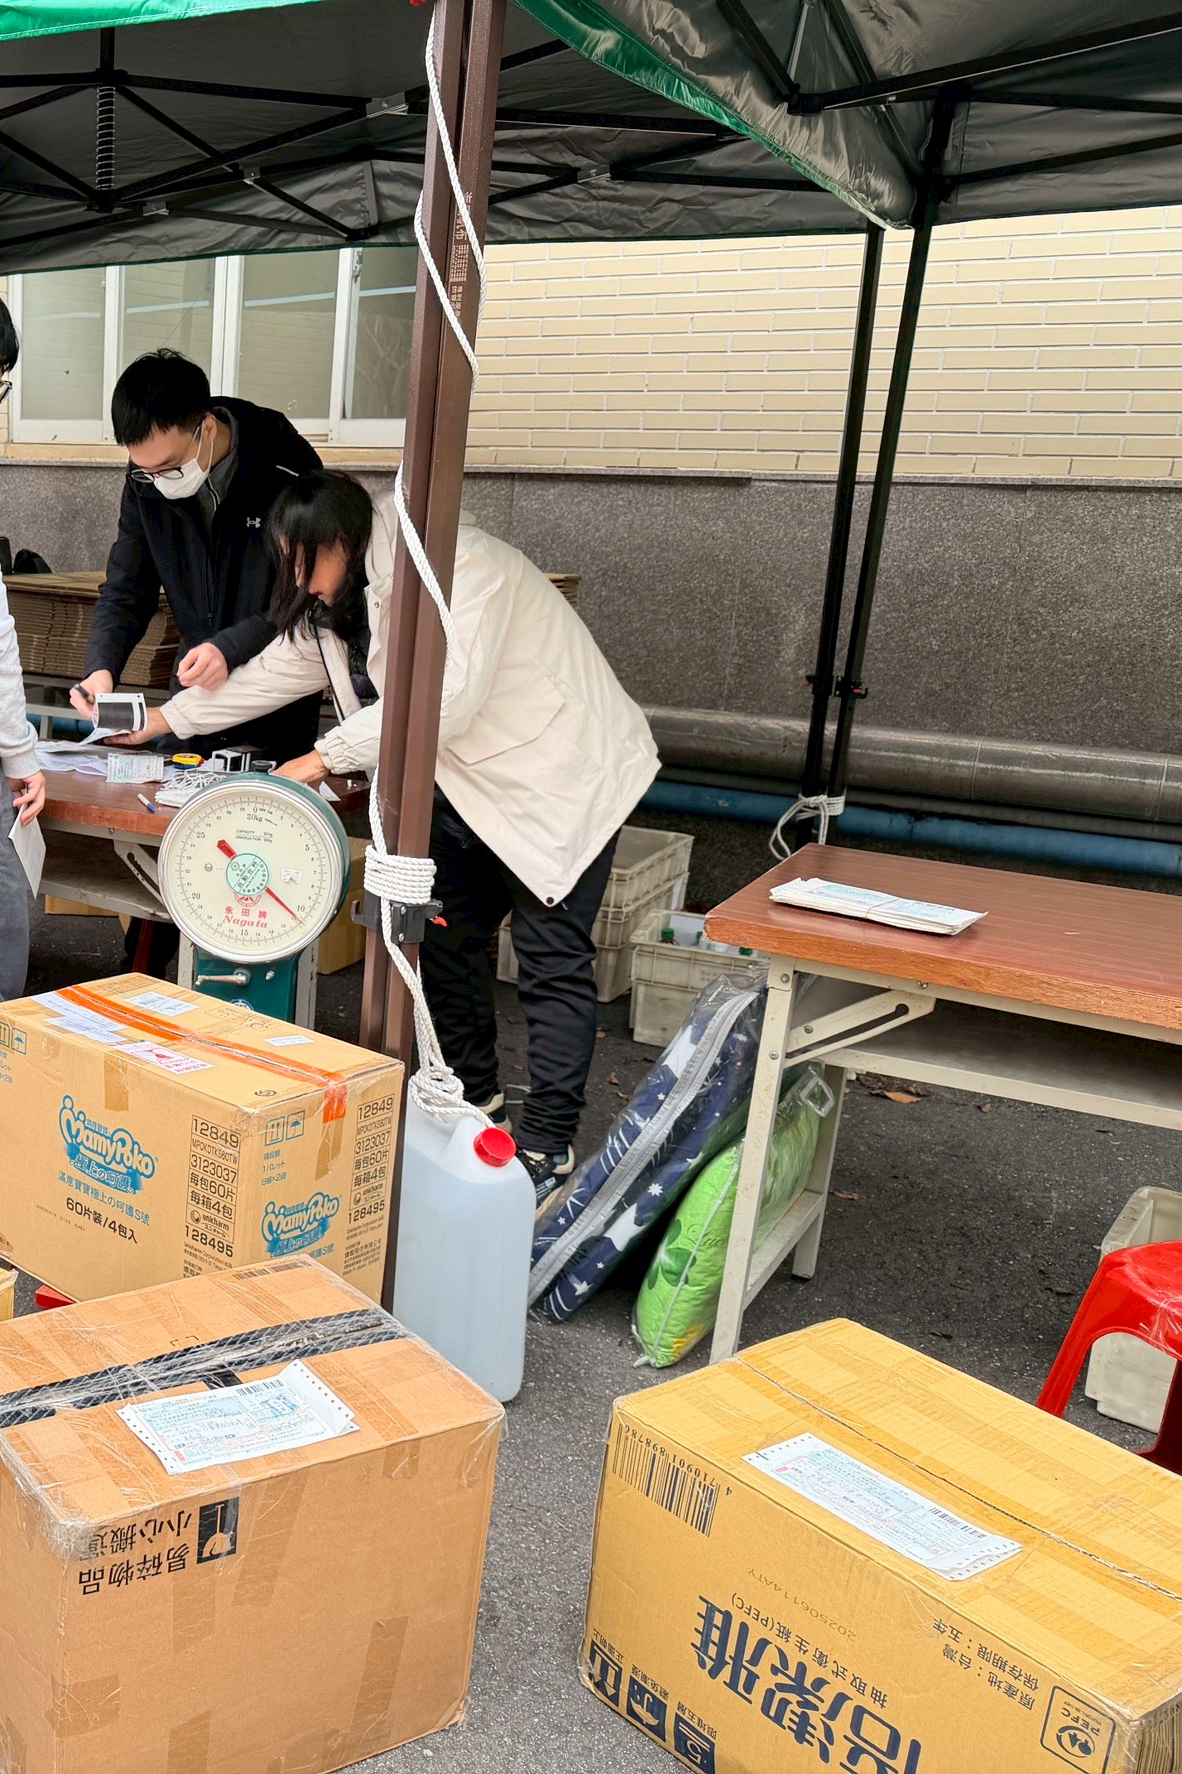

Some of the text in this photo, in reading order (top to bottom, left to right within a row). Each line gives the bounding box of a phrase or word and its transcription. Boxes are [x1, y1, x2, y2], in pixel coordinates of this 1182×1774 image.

[192, 892, 201, 900] 20
[296, 905, 305, 913] 10
[222, 915, 268, 929] Nagata
[240, 929, 249, 937] 15
[358, 1098, 393, 1121] 12849
[59, 1095, 156, 1179] MamyPoko
[192, 1118, 239, 1148] 12849
[355, 1131, 391, 1155] 3123037
[190, 1154, 237, 1184] 3123037
[66, 1197, 138, 1244] 60片裝/4包入
[202, 1213, 230, 1231] unicharm
[261, 1191, 340, 1243] MamyPoko
[348, 1199, 385, 1224] 128495
[185, 1225, 234, 1258] 128495
[672, 1453, 716, 1488] 710901
[726, 1486, 733, 1496] 4
[78, 1543, 190, 1596] 易碎物品
[592, 1627, 624, 1663] 正面朝上
[731, 1592, 888, 1709] 抽取式衛生紙(PEFC)
[691, 1595, 922, 1774] 倍潔雅
[1061, 1707, 1101, 1737] PEFC
